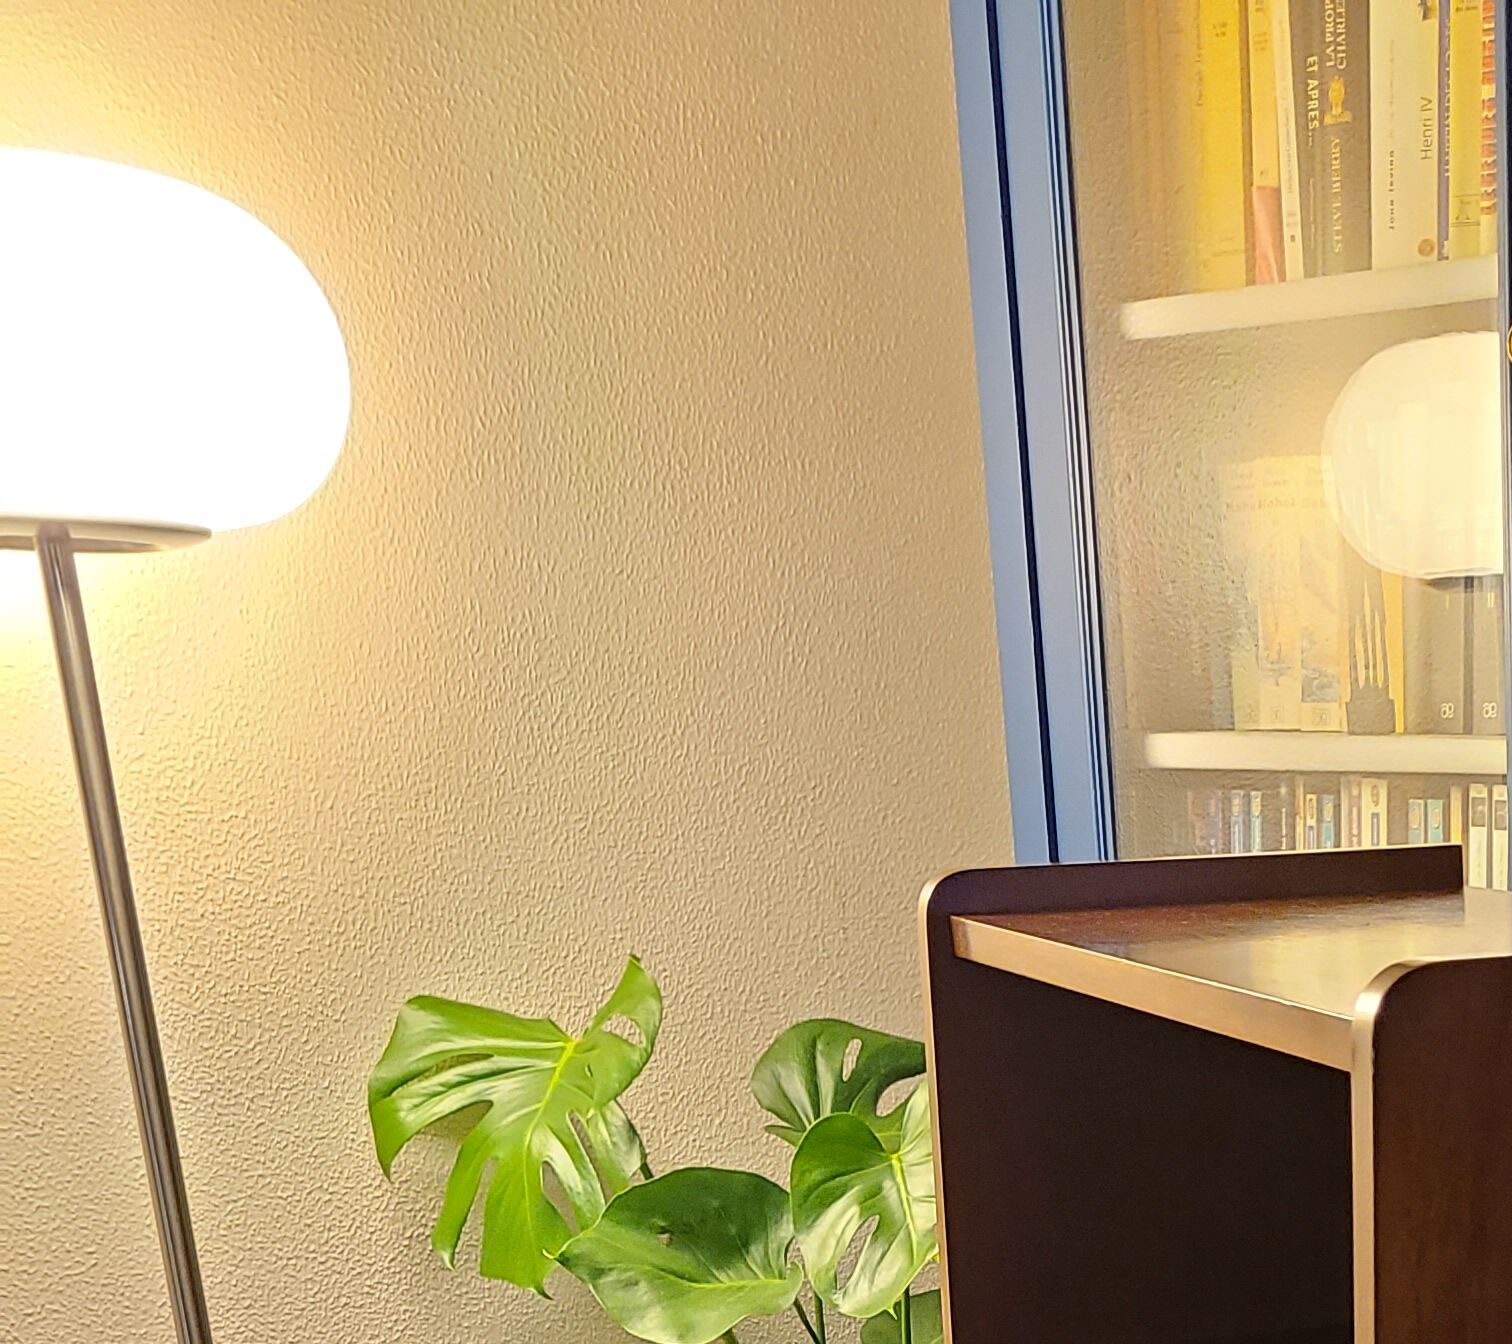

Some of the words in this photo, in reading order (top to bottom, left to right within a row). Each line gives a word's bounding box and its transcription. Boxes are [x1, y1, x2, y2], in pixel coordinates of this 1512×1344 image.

[1325, 0, 1337, 41] PROP
[1306, 55, 1318, 73] ET
[1325, 44, 1337, 67] LA
[1419, 95, 1433, 114] IV
[1419, 117, 1434, 161] Henri
[1330, 137, 1342, 194] BERRY
[1331, 199, 1343, 254] STEVE
